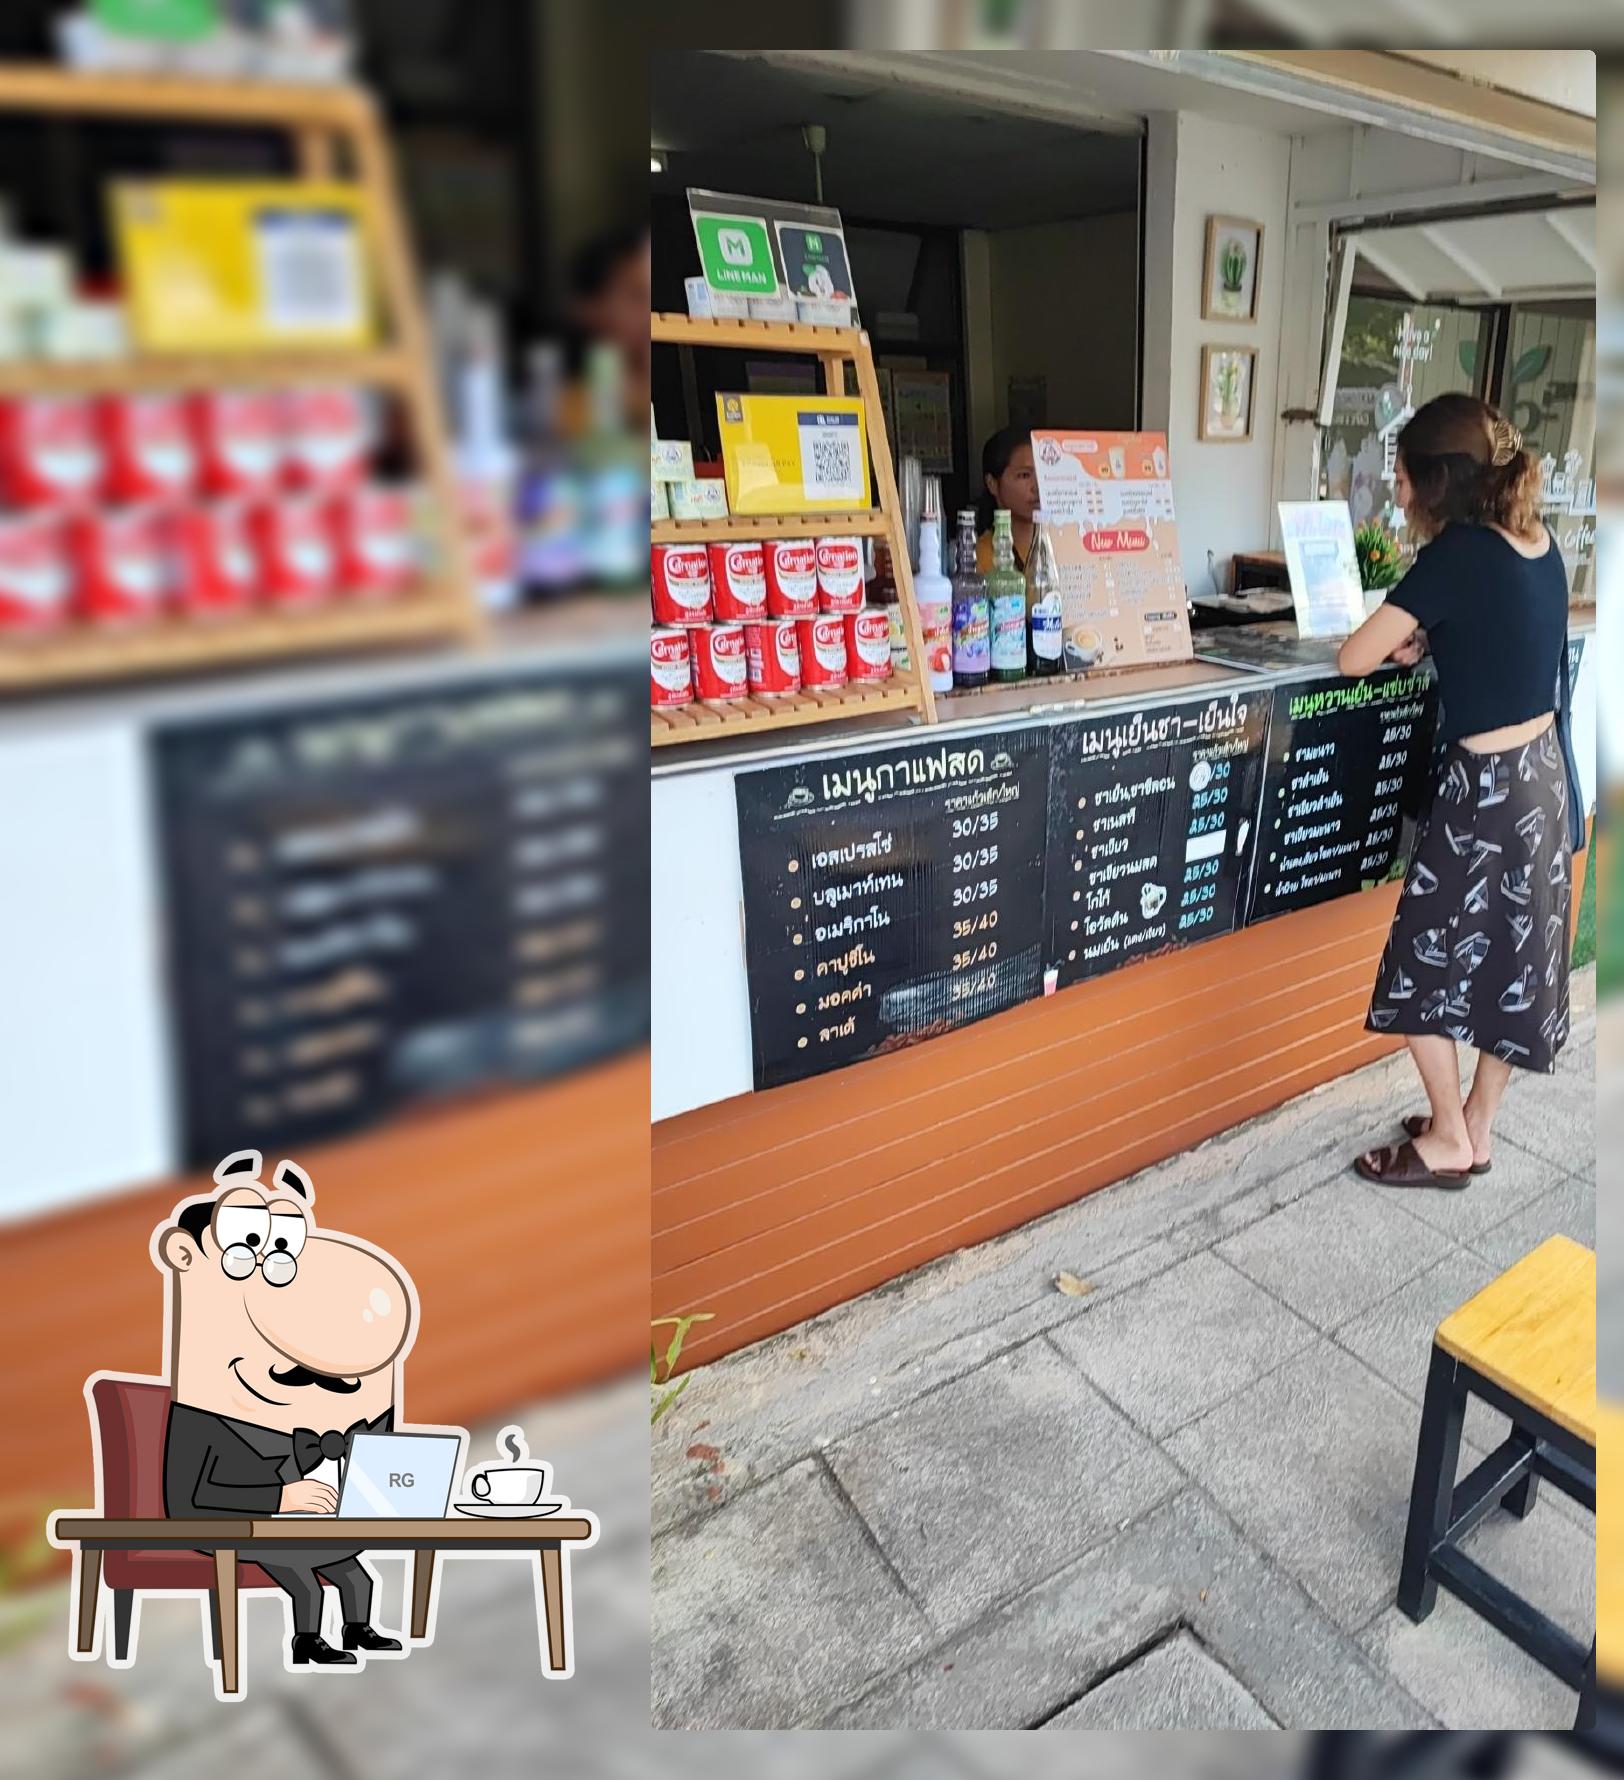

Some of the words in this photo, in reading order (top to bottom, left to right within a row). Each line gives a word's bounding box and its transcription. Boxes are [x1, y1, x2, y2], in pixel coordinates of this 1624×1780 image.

[742, 270, 767, 286] MAN
[818, 547, 858, 566] Carnation
[822, 747, 985, 803] เมนูกาแฟสด
[1191, 786, 1229, 810] 25/30
[952, 811, 999, 838] 30/35
[1188, 811, 1225, 835] 25/30
[952, 845, 999, 873] 30/35
[1183, 859, 1220, 884] 25/30
[952, 879, 999, 906] 30/35
[1181, 882, 1216, 907] 25/30
[952, 911, 999, 939] 35/40
[1178, 905, 1214, 930] 25/30
[952, 943, 998, 971] 35/40
[951, 972, 997, 1002] 35/40
[819, 1016, 856, 1044] ลาเต้
